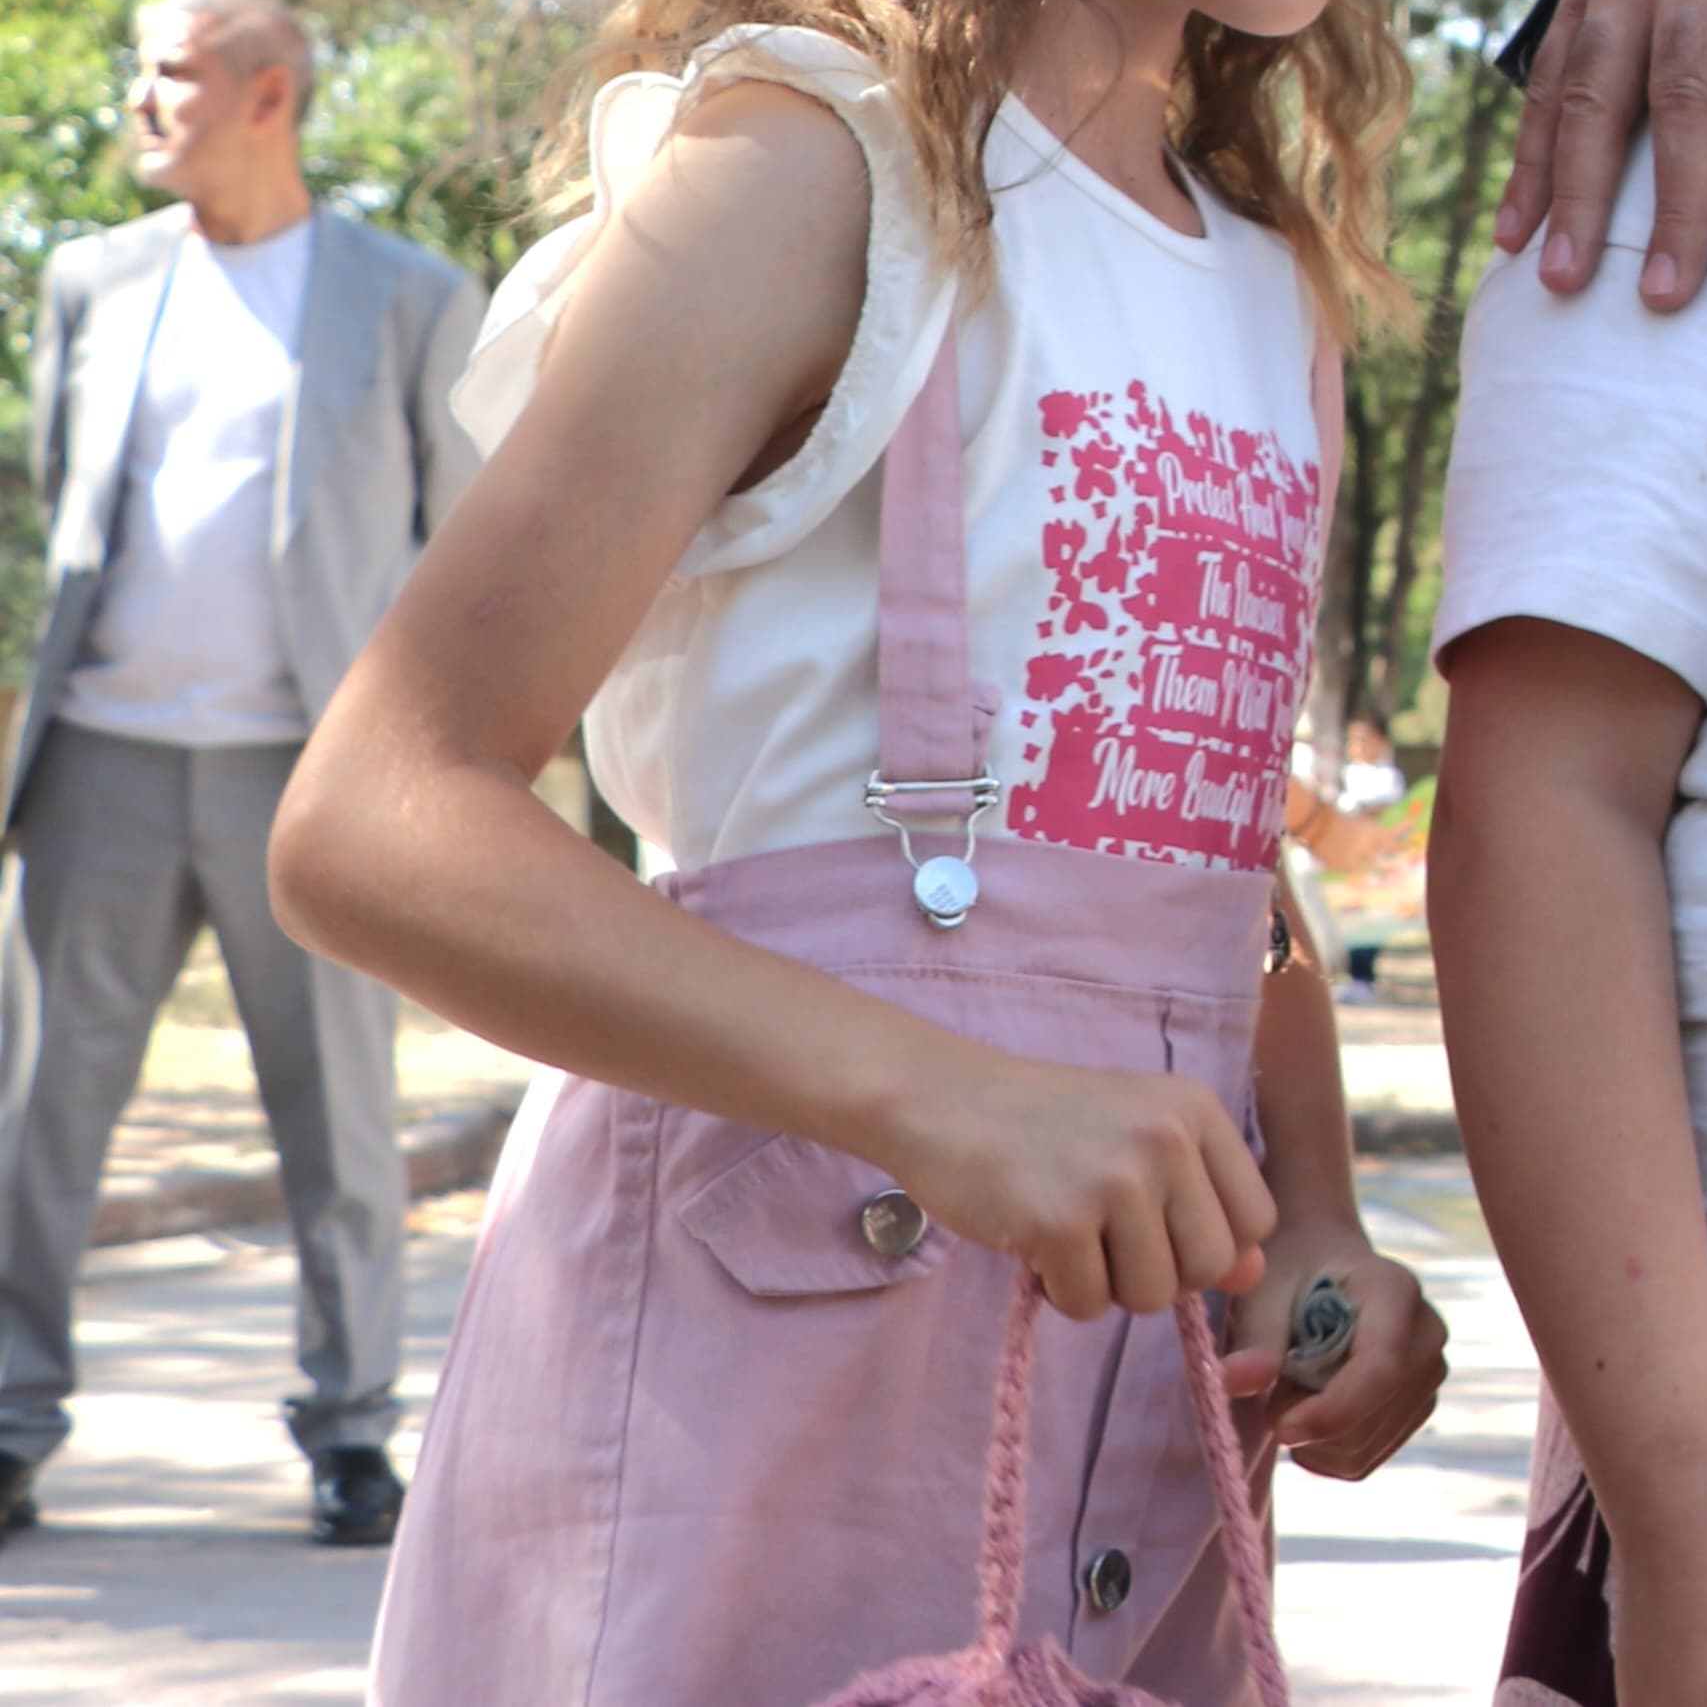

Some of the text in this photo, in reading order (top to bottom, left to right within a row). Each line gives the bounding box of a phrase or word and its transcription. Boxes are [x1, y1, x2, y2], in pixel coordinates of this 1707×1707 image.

[1196, 549, 1232, 620] The
[1149, 644, 1219, 716] Them
[1087, 736, 1177, 816] More
